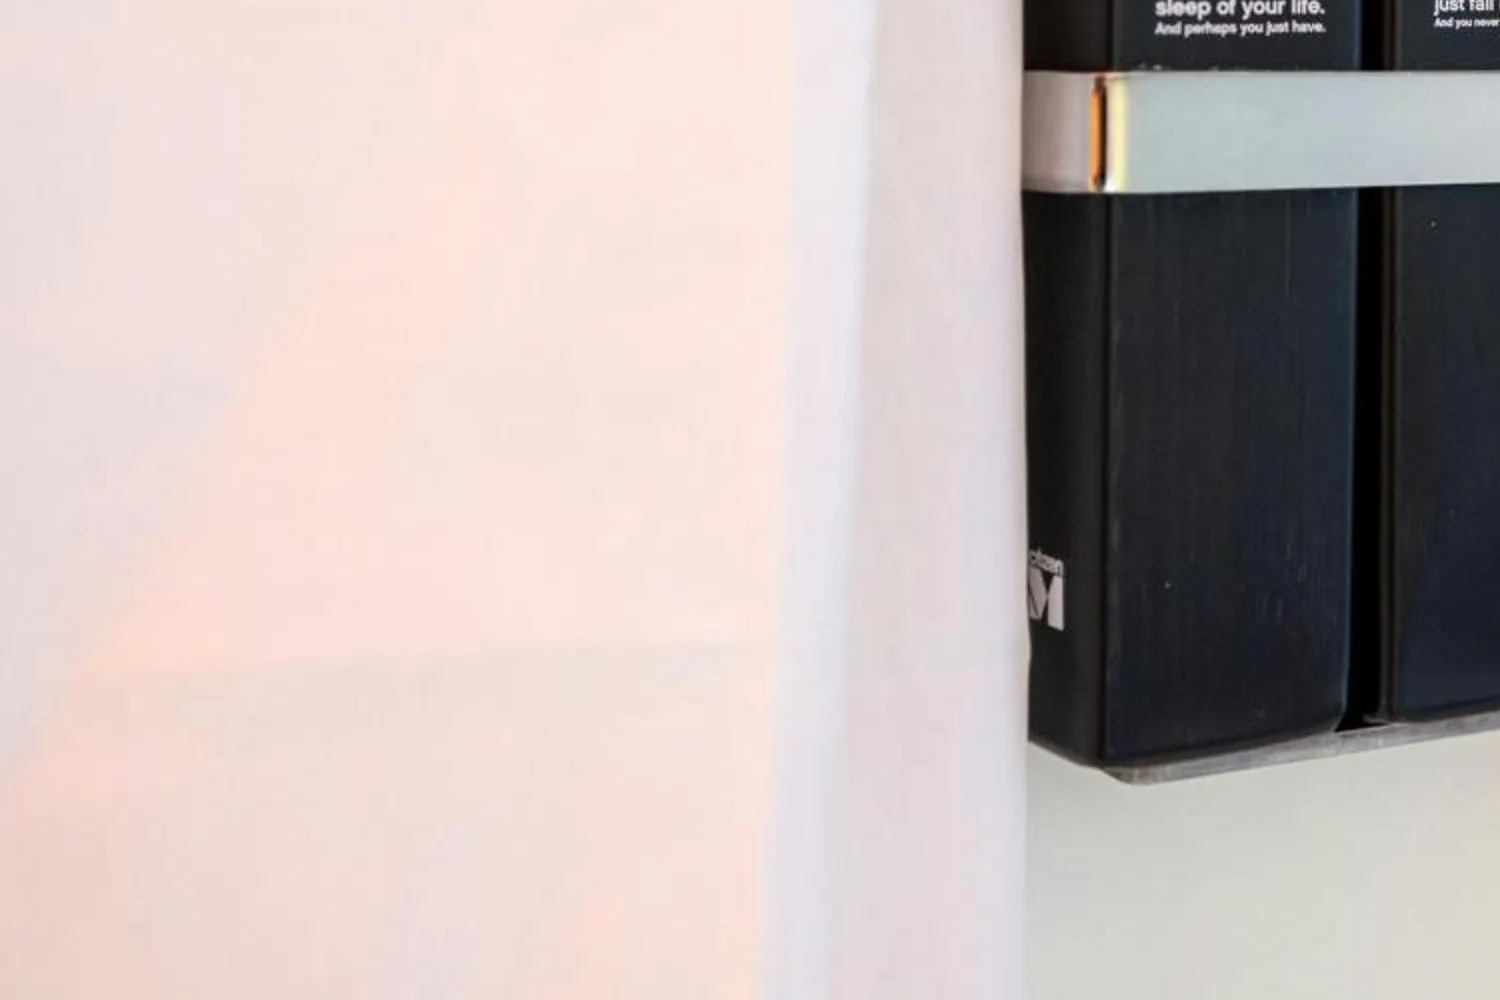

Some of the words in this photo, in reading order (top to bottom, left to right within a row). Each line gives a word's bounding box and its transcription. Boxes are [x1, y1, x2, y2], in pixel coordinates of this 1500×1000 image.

[1241, 0, 1286, 19] your
[1155, 21, 1182, 35] And
[1184, 21, 1237, 38] perhaps
[1240, 23, 1263, 36] you
[1265, 21, 1288, 35] just
[1291, 20, 1326, 32] have.
[1455, 19, 1472, 30] you
